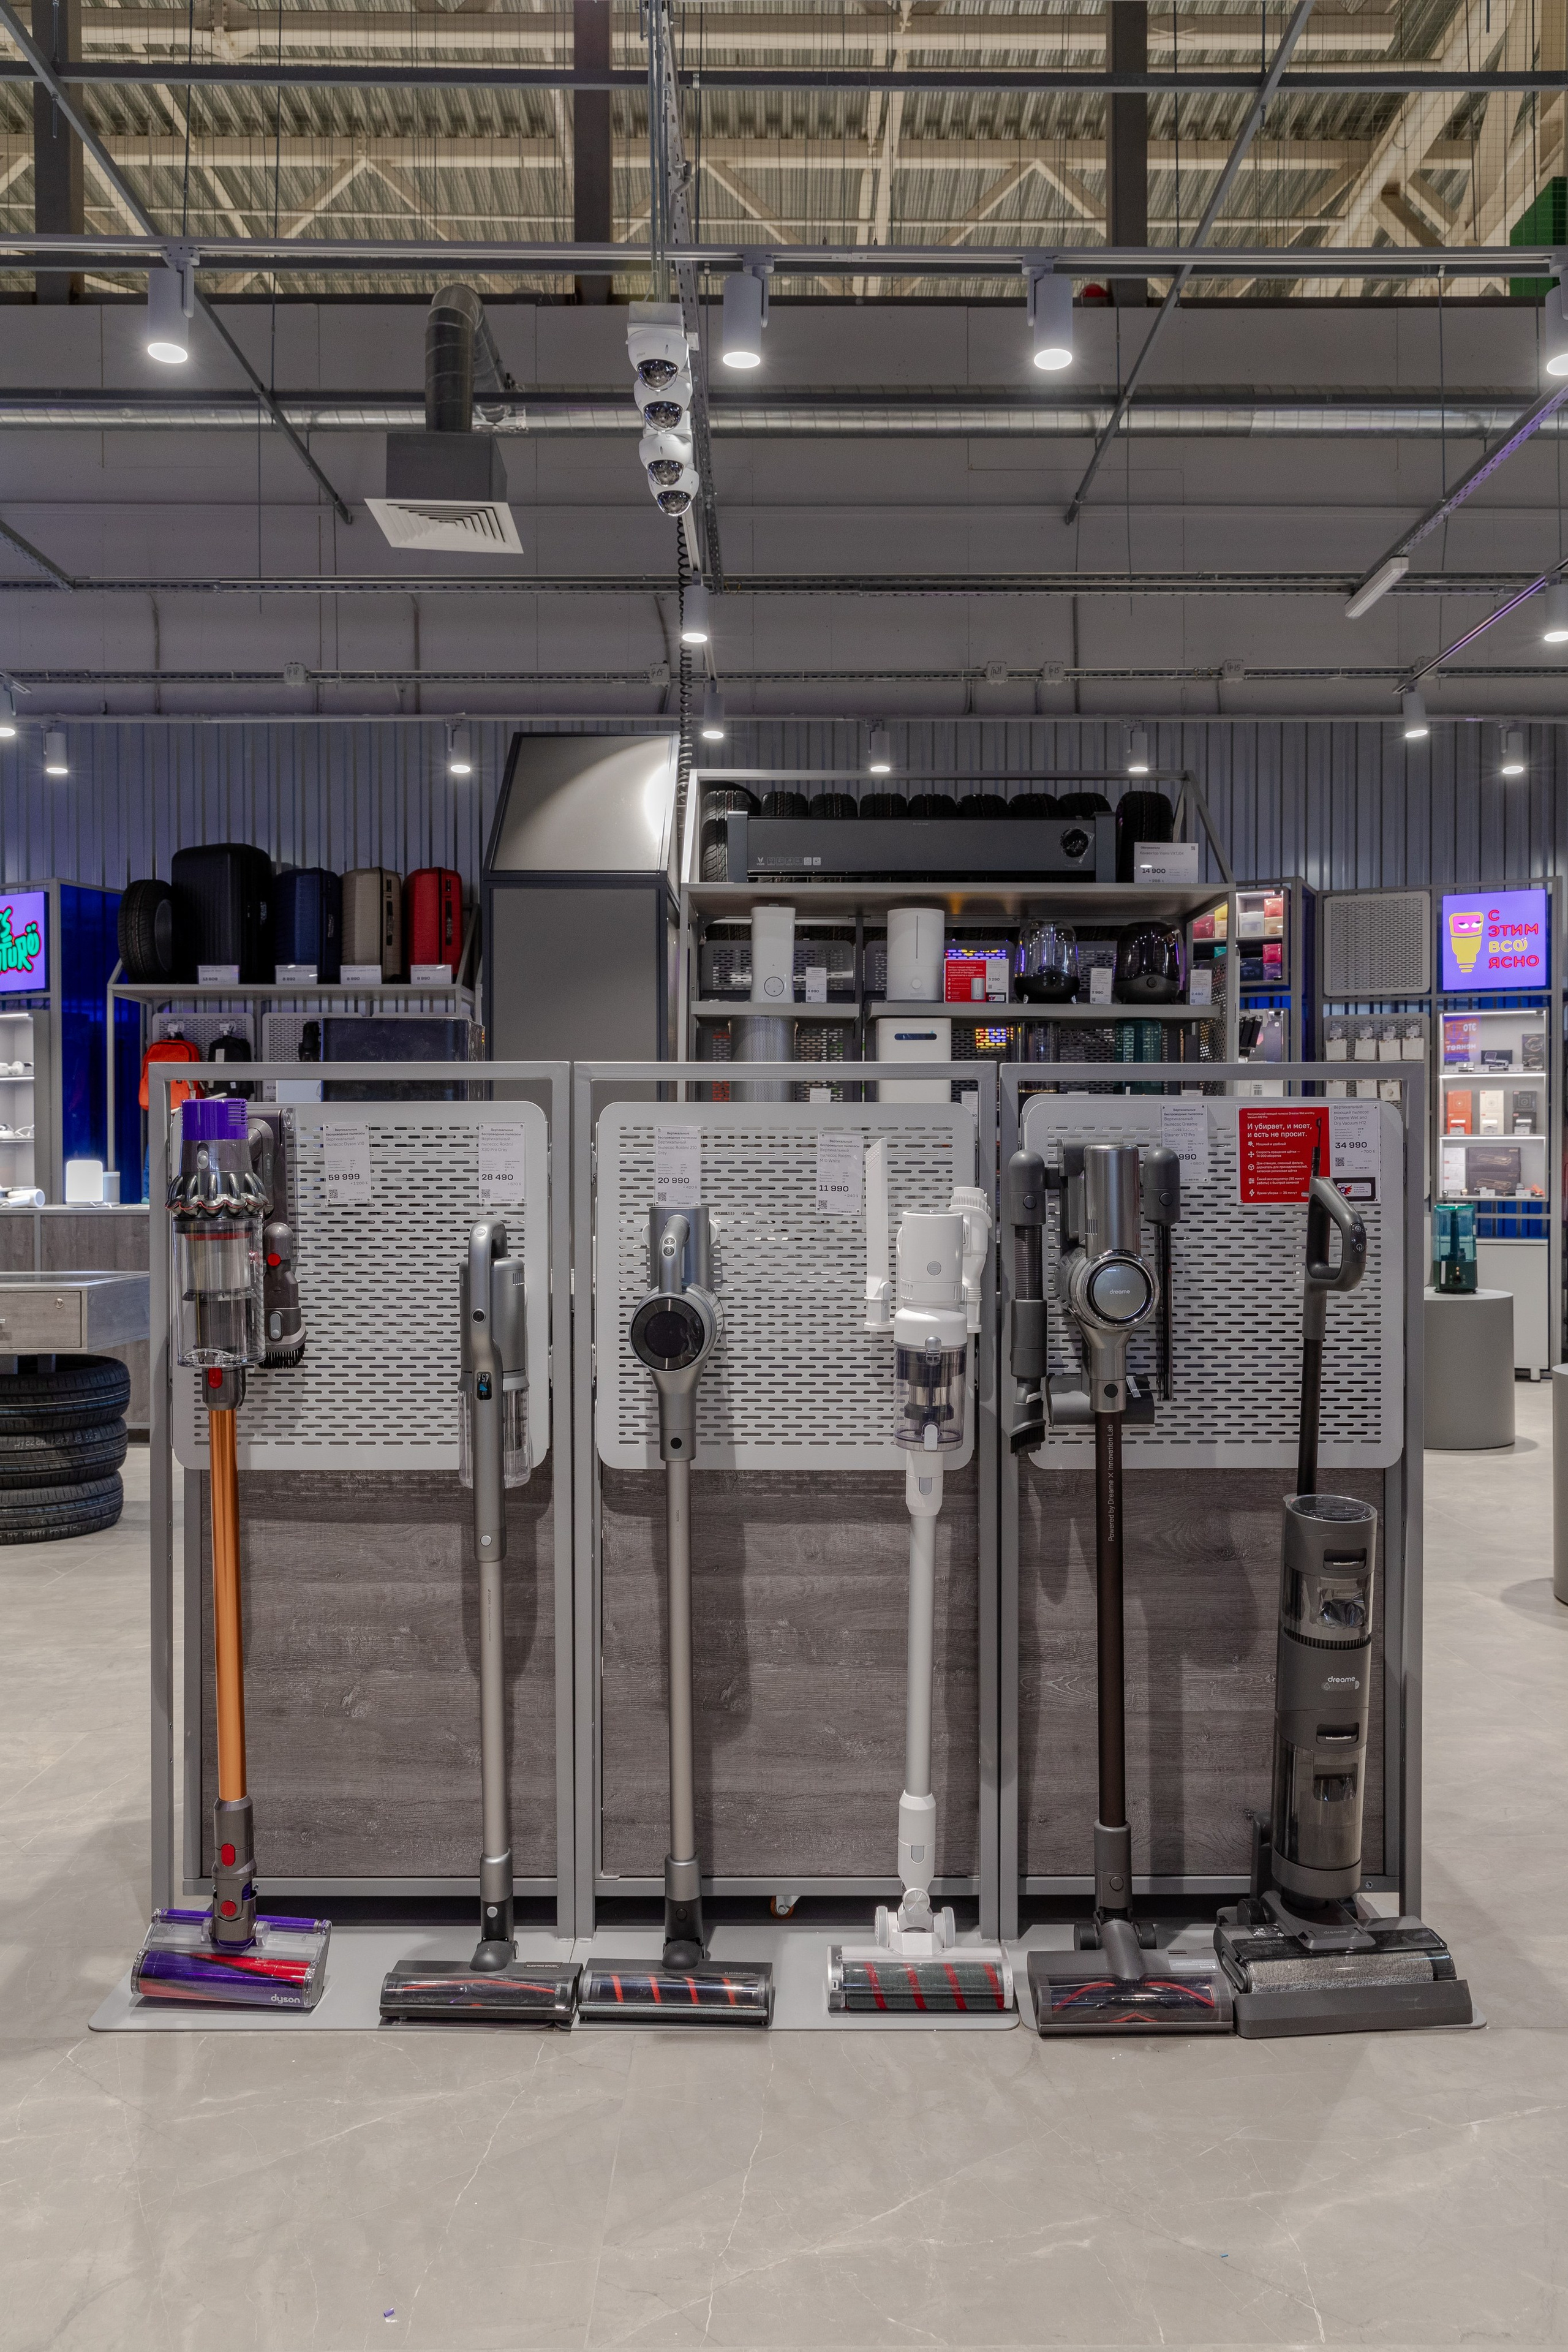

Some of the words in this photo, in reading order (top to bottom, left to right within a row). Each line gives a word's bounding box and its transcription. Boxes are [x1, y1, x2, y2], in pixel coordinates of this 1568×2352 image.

[1488, 910, 1499, 921] С
[1488, 923, 1539, 937] ЭТИМ
[1489, 955, 1539, 969] ЯСНО
[271, 1994, 300, 2003] dyson
